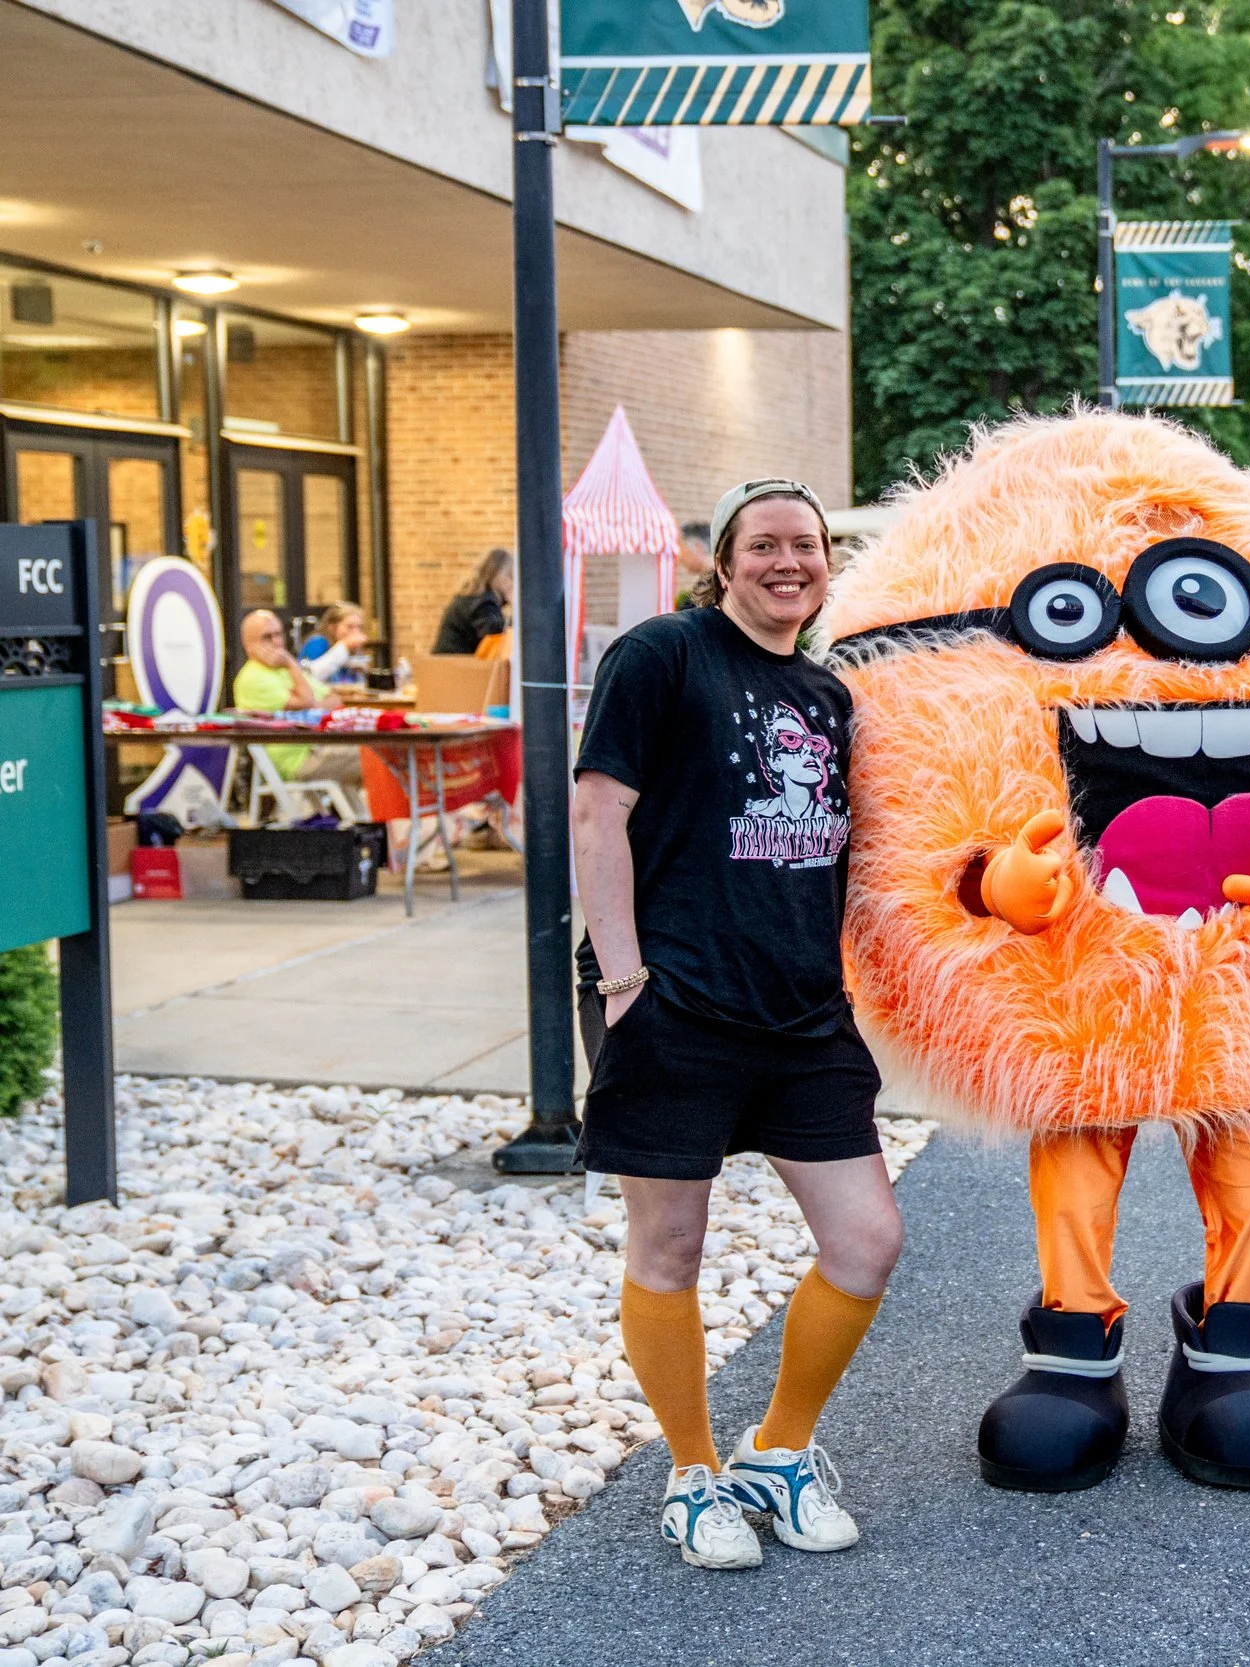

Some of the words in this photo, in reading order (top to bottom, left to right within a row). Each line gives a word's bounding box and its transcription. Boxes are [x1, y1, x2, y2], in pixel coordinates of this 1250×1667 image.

[18, 558, 64, 594] FCC
[0, 758, 28, 794] er
[729, 816, 792, 860] TRAILER
